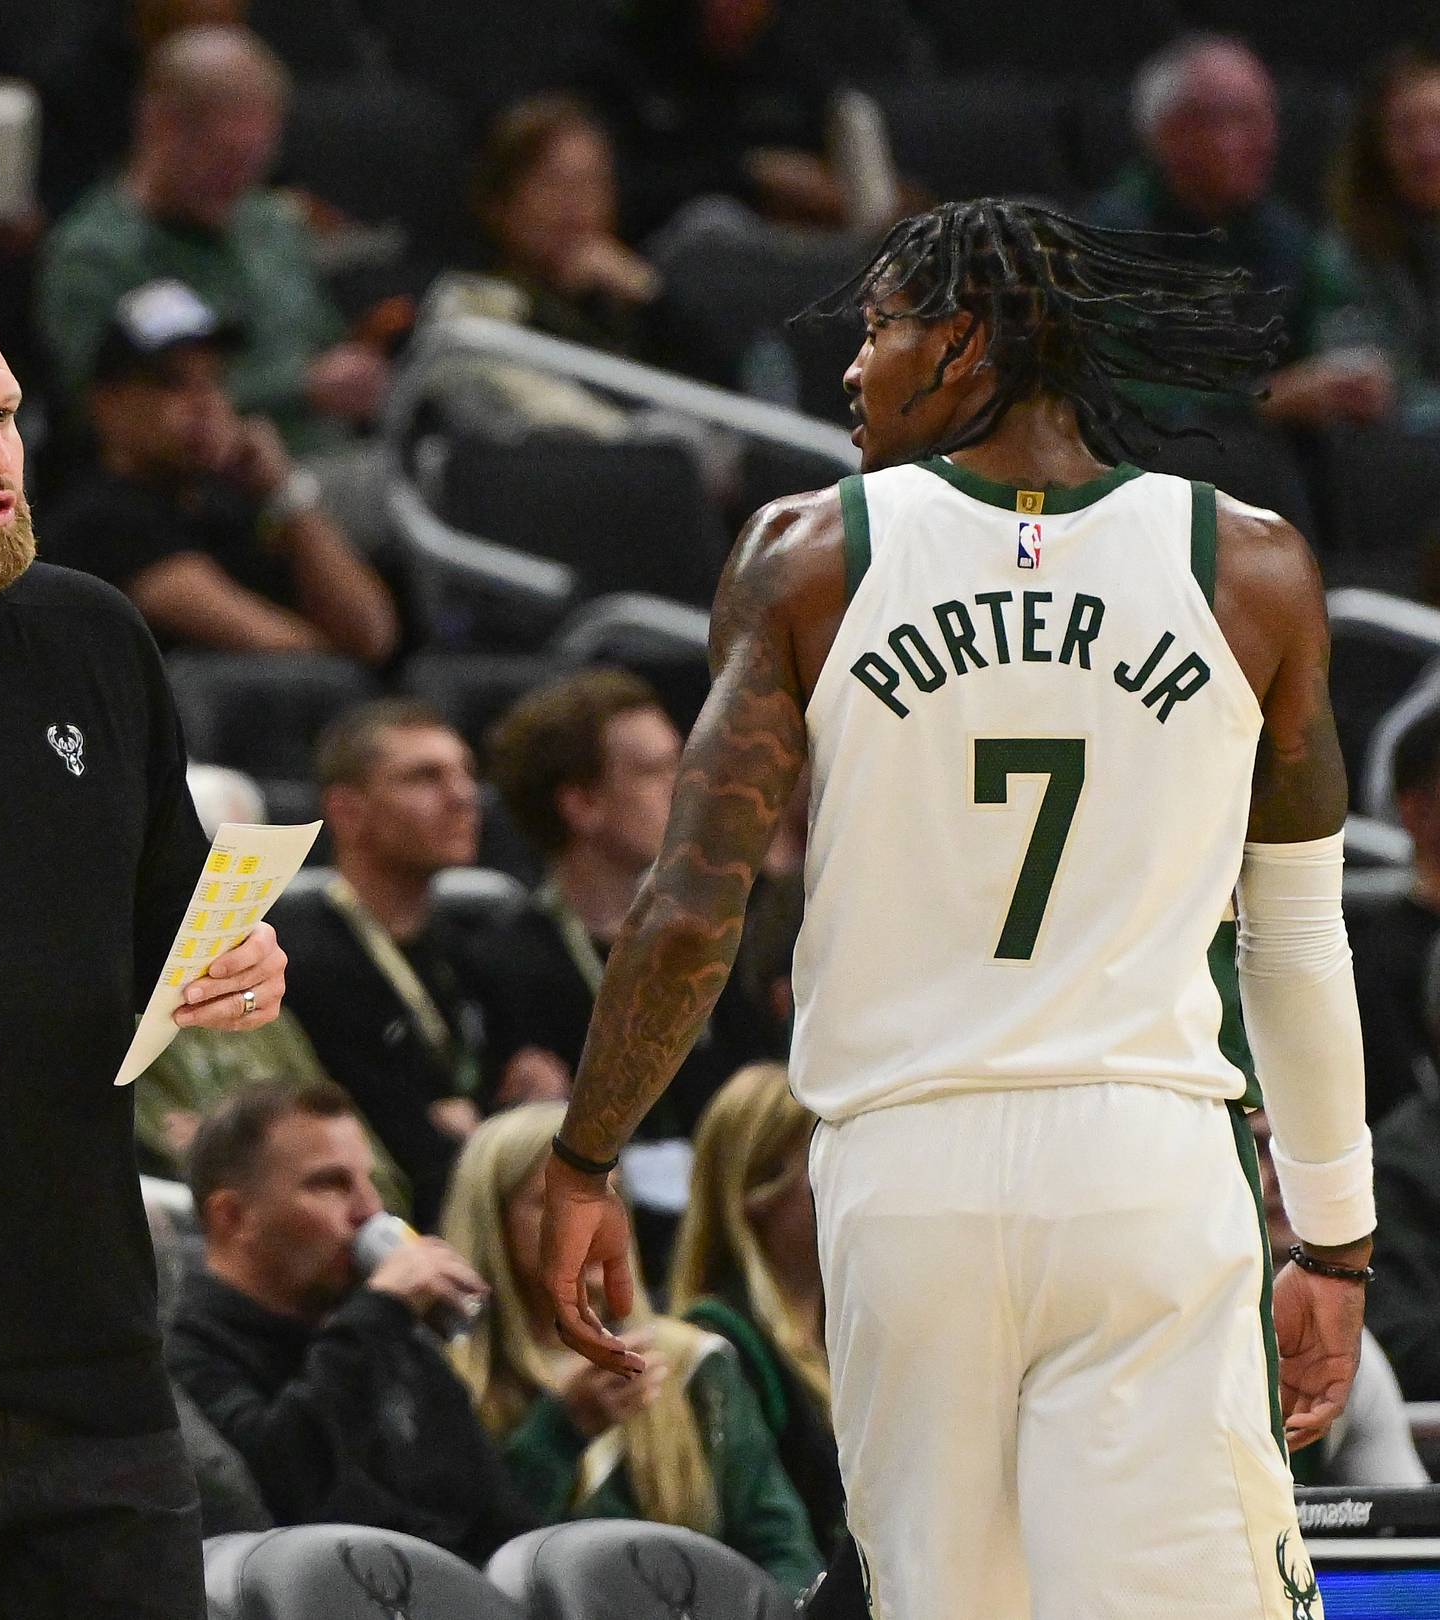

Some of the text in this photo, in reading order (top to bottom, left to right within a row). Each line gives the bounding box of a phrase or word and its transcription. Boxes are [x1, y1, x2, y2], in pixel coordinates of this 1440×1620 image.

[850, 591, 1211, 724] PORTER JR
[973, 738, 1086, 961] 7
